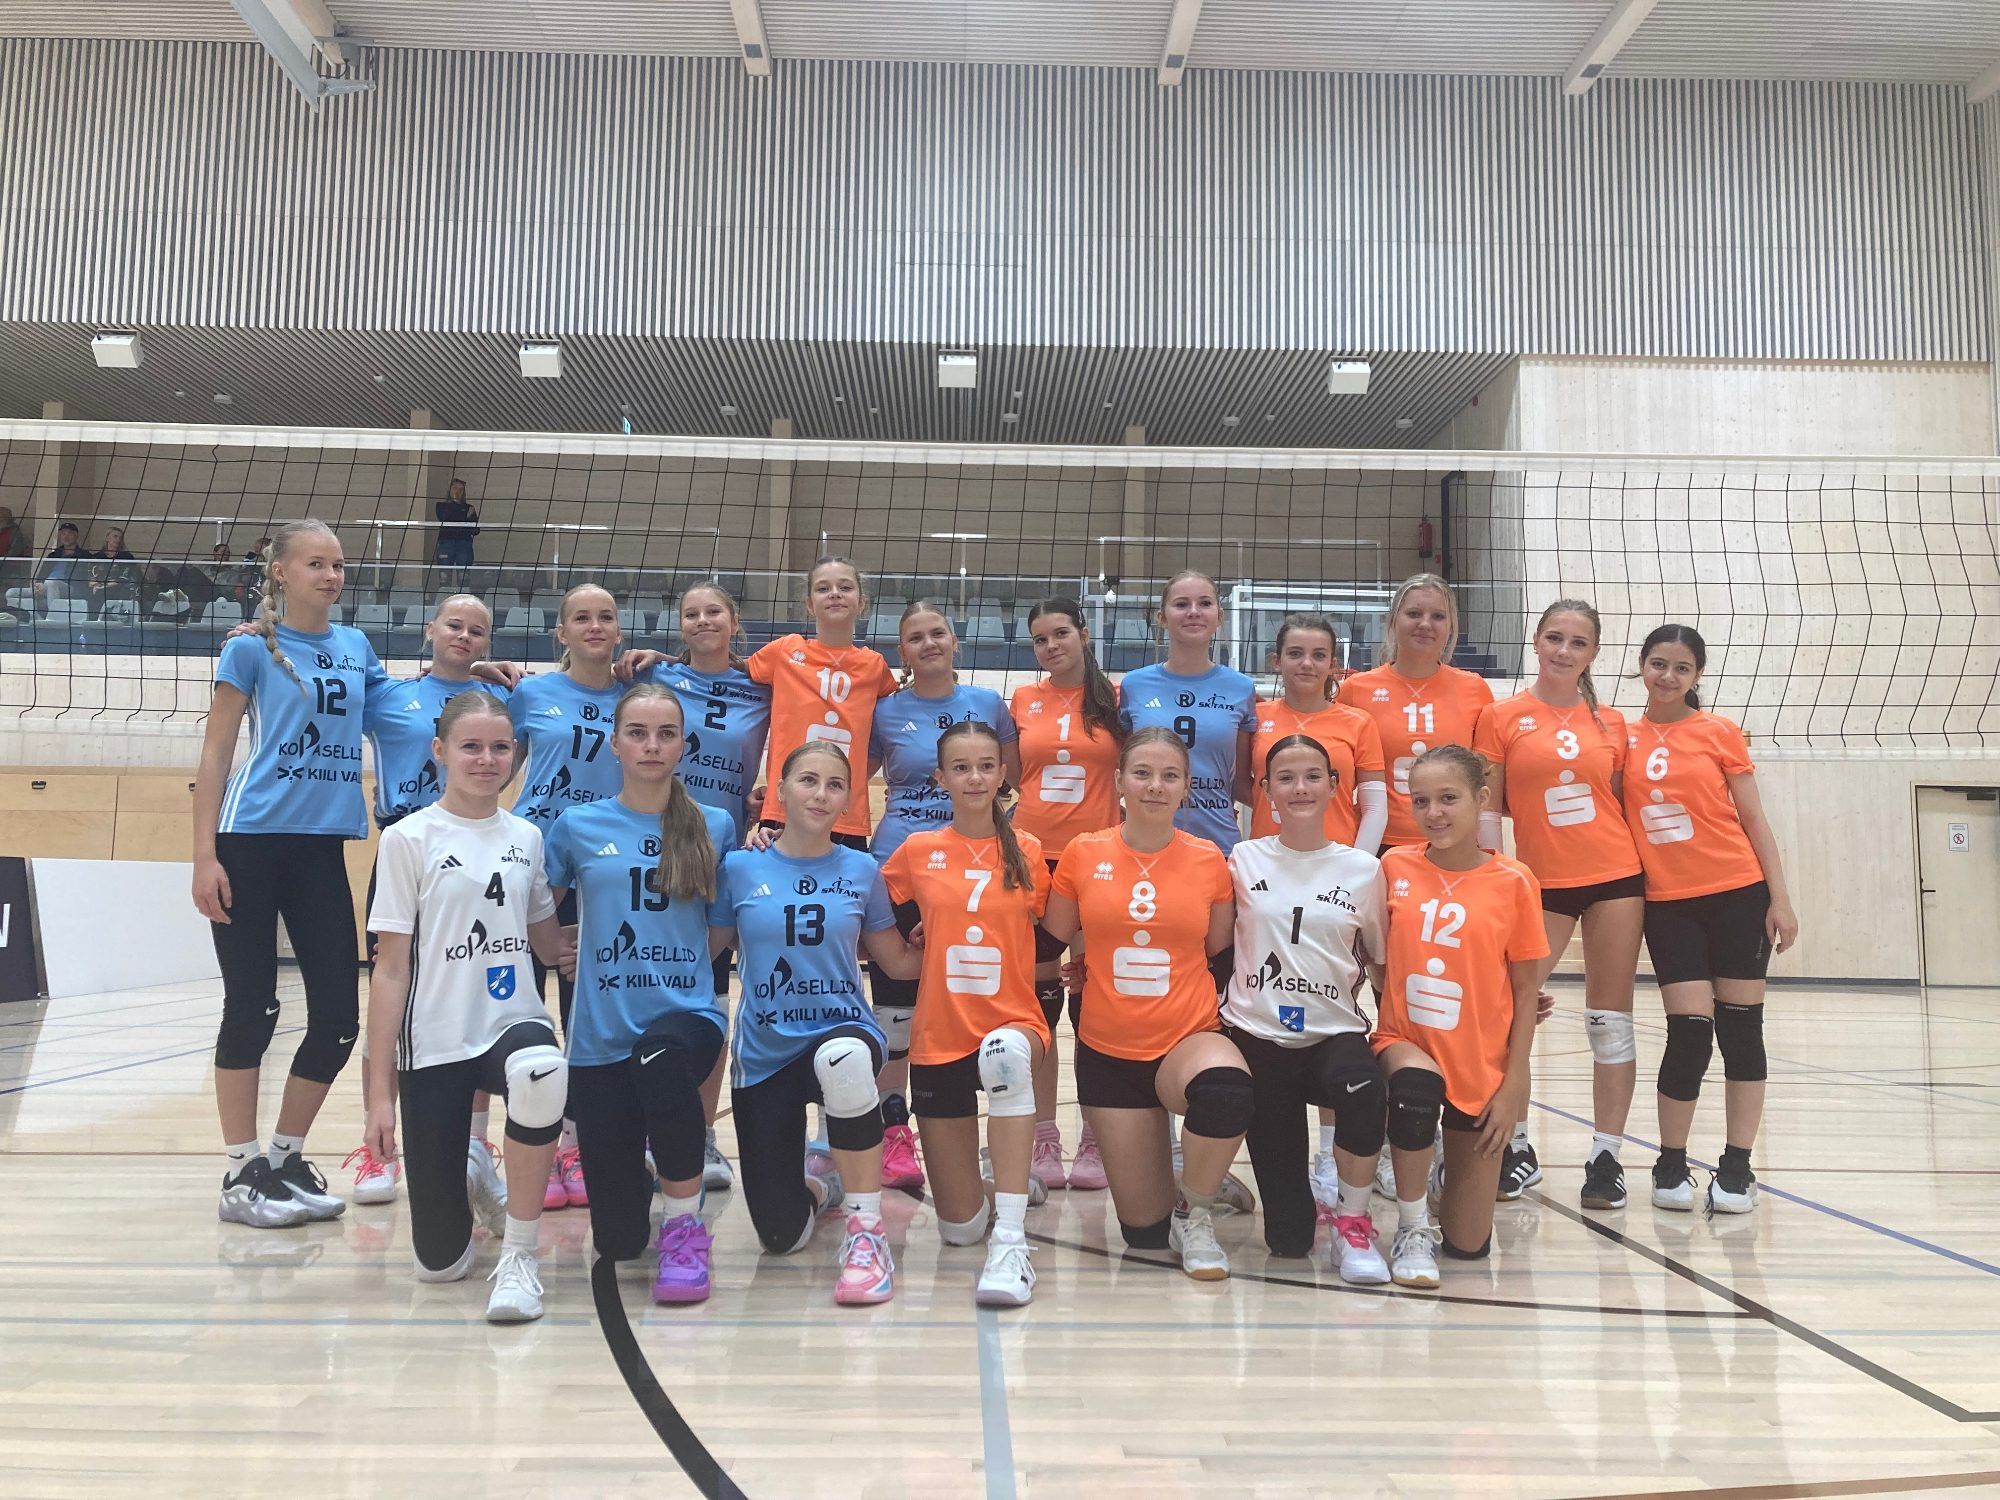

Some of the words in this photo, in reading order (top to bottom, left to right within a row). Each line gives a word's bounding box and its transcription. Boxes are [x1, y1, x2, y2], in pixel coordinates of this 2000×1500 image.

[312, 677, 347, 716] 12
[817, 667, 852, 703] 10
[704, 700, 727, 730] 2
[1057, 713, 1071, 741] 1
[1174, 715, 1196, 749] 9
[1402, 702, 1434, 733] 11
[571, 724, 606, 762] 17
[1556, 730, 1580, 760] 3
[307, 767, 337, 781] KIILI
[341, 770, 362, 784] VAL
[1646, 746, 1670, 780] 6
[684, 774, 715, 790] KIILI
[484, 871, 505, 907] 4
[964, 869, 992, 912] 7
[1127, 880, 1157, 922] 8
[783, 903, 826, 947] 13
[1291, 906, 1303, 944] 1
[1419, 898, 1467, 949] 12
[626, 973, 660, 988] KIILI
[661, 975, 697, 988] VALD
[783, 1007, 817, 1022] KIILI
[821, 1006, 862, 1020] VALD
